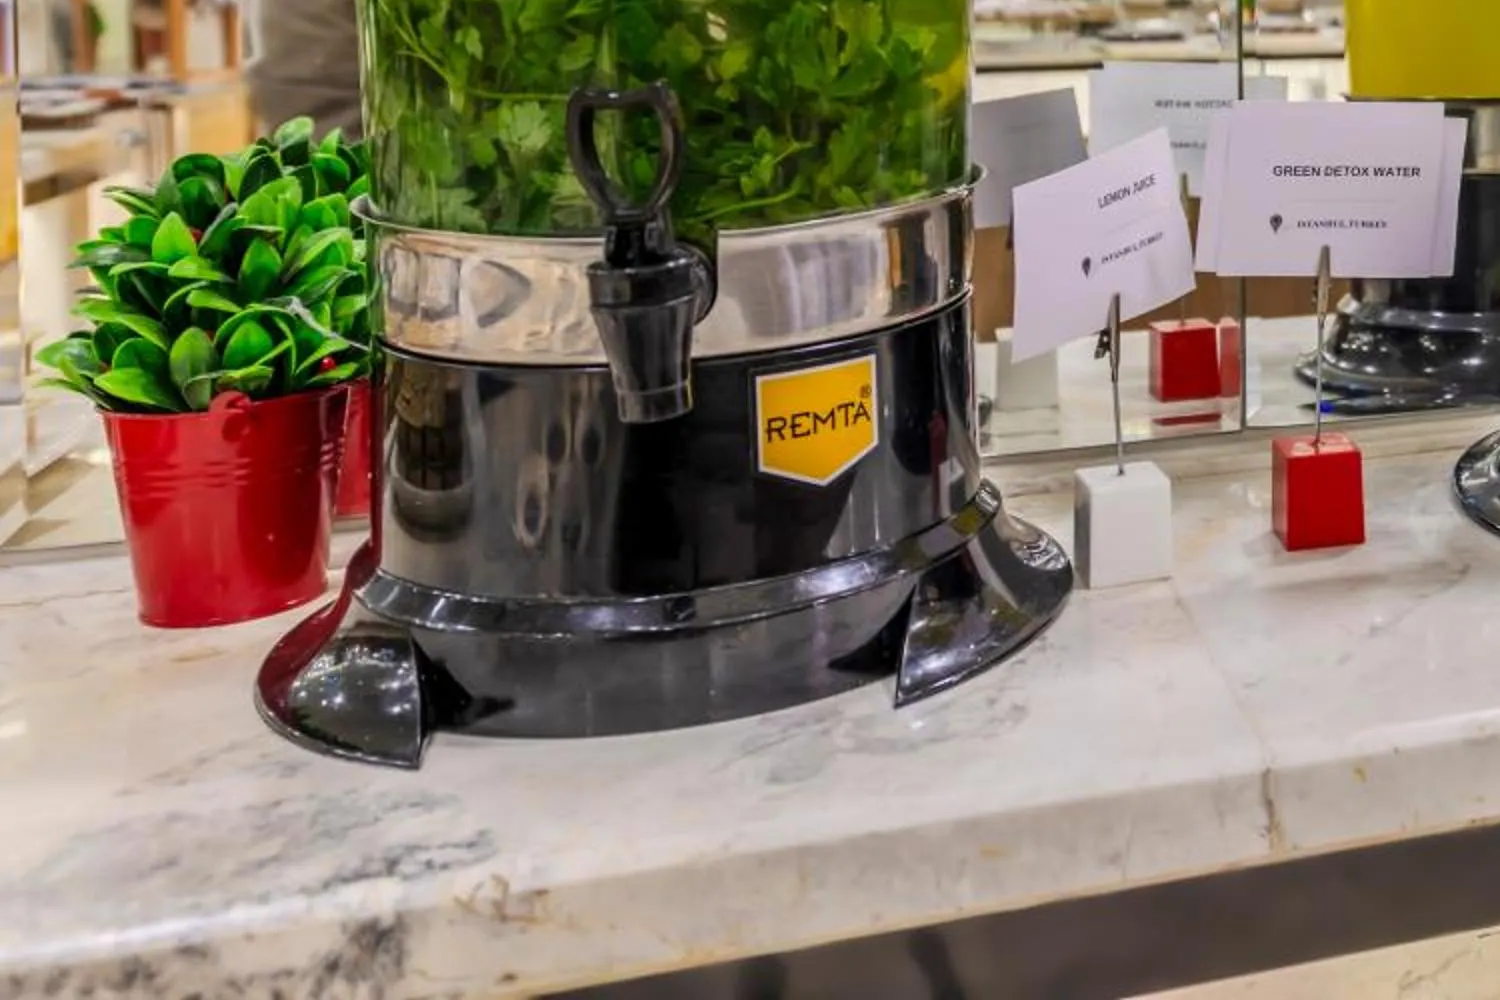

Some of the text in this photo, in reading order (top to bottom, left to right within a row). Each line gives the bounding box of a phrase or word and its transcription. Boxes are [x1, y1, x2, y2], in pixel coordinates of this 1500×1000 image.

[1273, 165, 1421, 177] GREEN DETOX WATER
[1098, 173, 1157, 209] LEMON JUICE
[765, 400, 872, 443] REMTA
